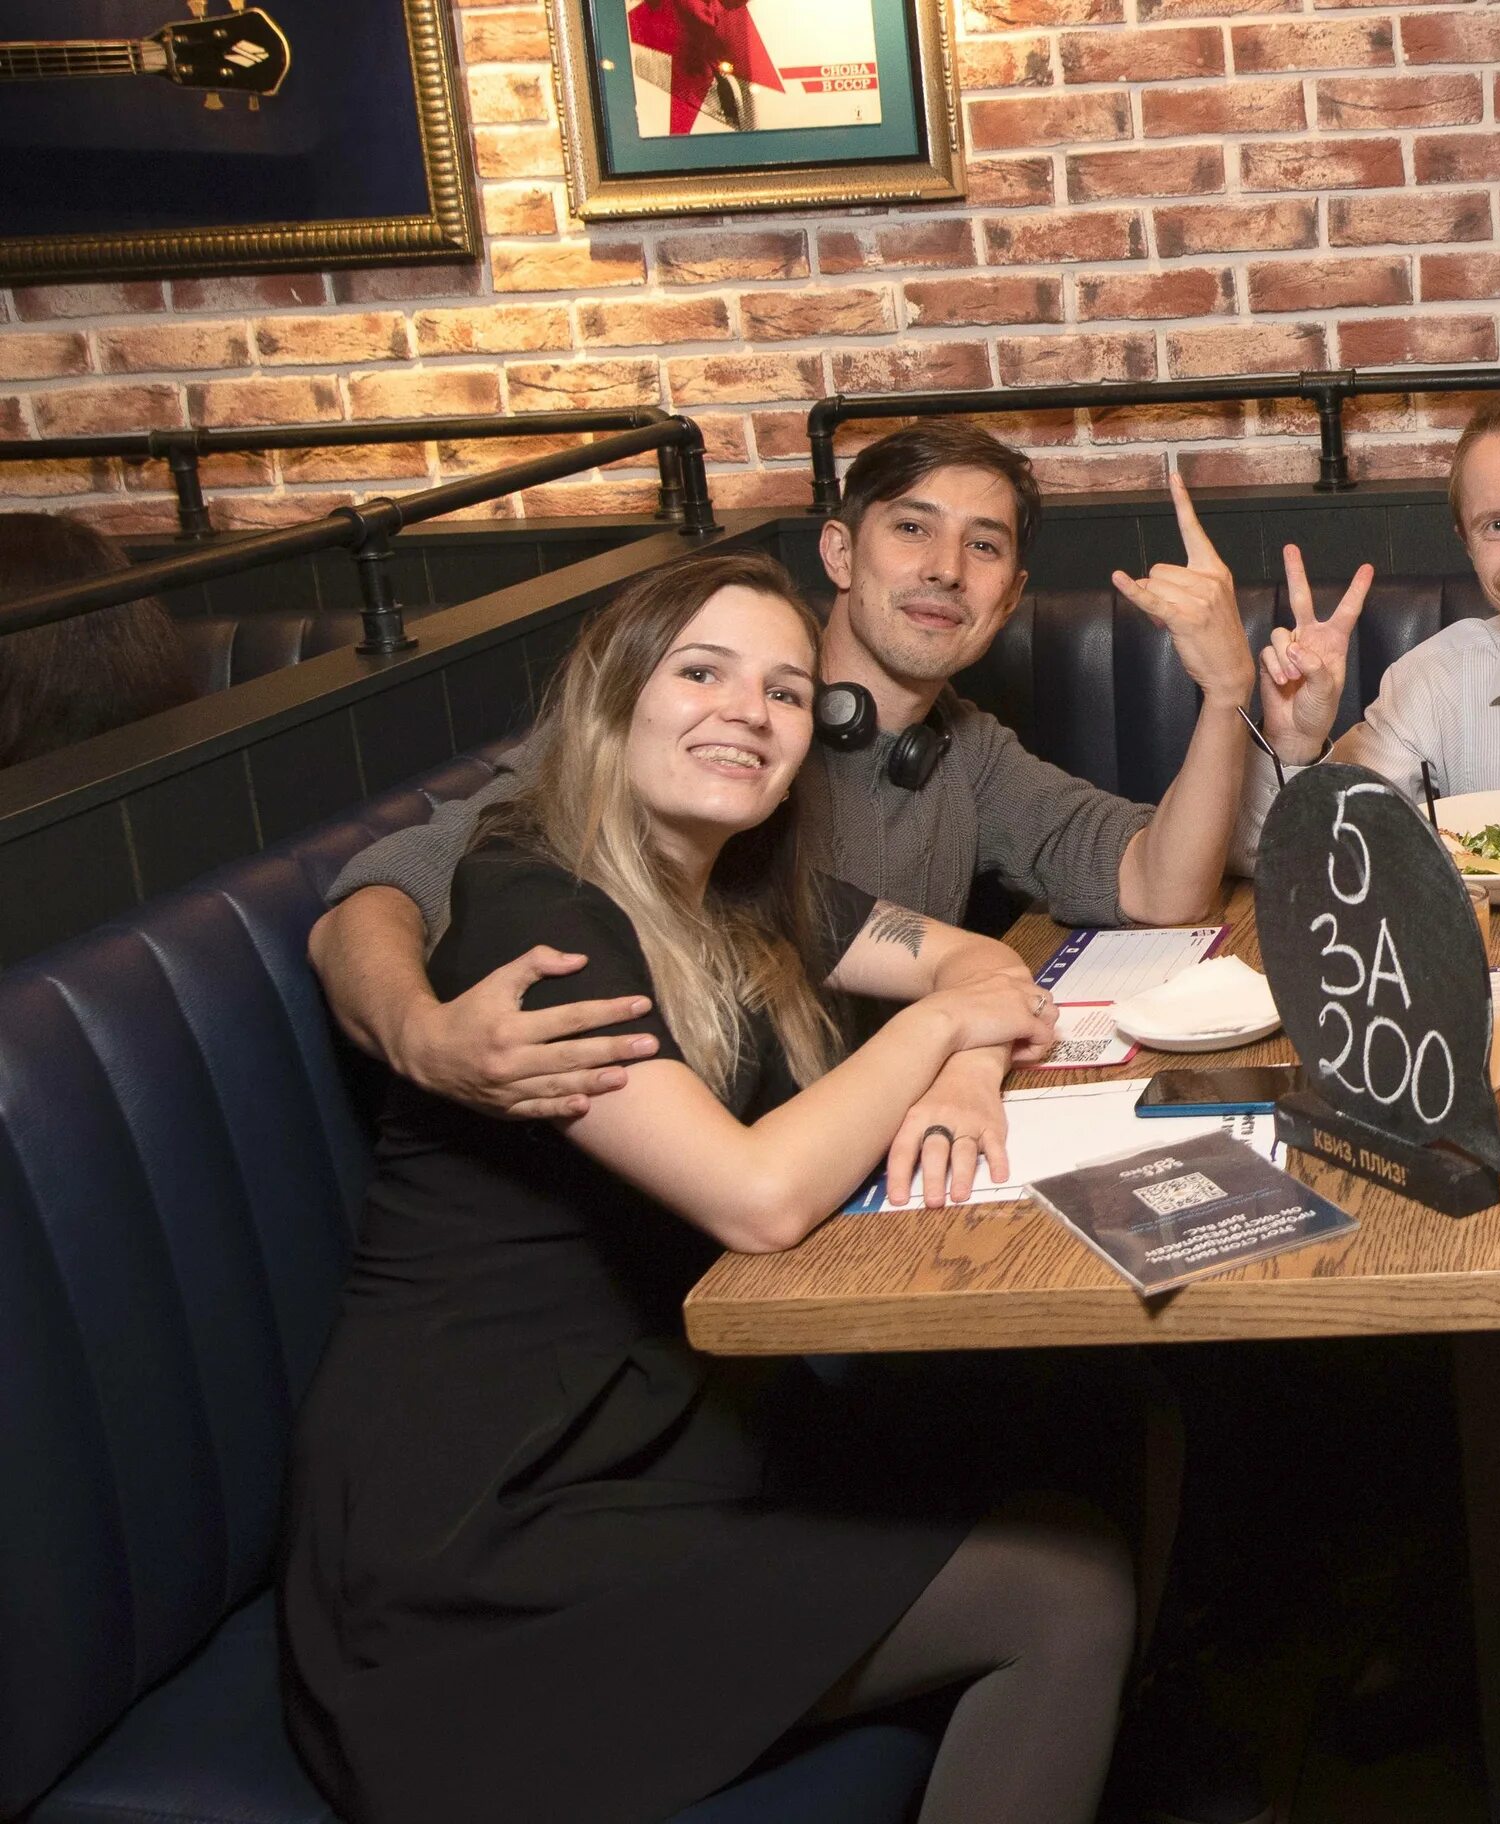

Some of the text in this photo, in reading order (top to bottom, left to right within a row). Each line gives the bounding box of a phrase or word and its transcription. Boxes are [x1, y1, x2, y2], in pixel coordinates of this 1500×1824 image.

[820, 63, 870, 77] СНОВА
[822, 79, 872, 92] В СССР
[1328, 783, 1394, 905] 5
[1319, 1001, 1455, 1124] 200
[1313, 1127, 1407, 1187] КВИЗ, ПЛИЗ!
[1280, 1206, 1302, 1216] ОН
[1216, 1213, 1247, 1228] ДЛЯ
[1230, 1223, 1243, 1232] И
[1244, 1213, 1280, 1229] ЧИСТ
[1185, 1224, 1296, 1264] ЭТОТ СТОЛ БЫЛ
